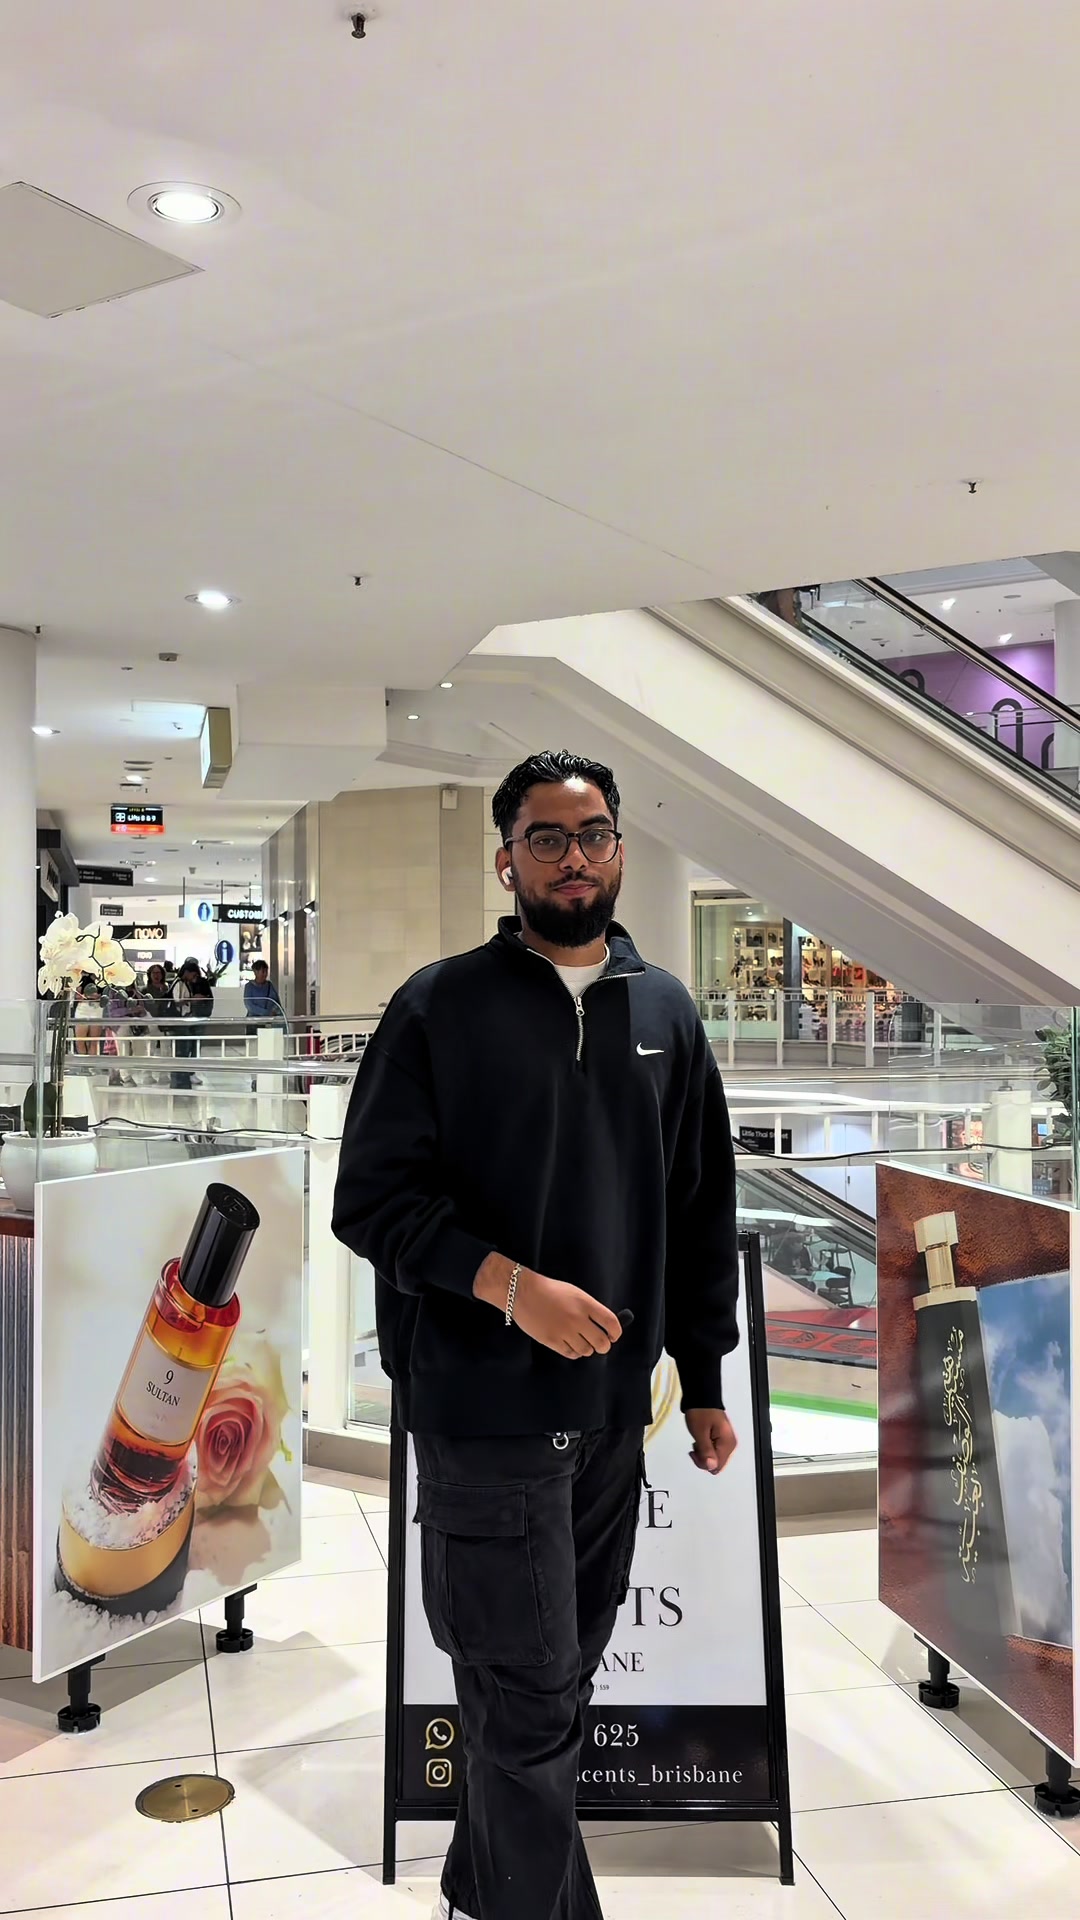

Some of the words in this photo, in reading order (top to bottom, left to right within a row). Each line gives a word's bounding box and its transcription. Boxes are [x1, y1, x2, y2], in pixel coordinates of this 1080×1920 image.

[134, 928, 164, 940] novo
[163, 1370, 174, 1385] 9
[146, 1381, 181, 1406] SULTAN
[593, 1723, 639, 1747] 625
